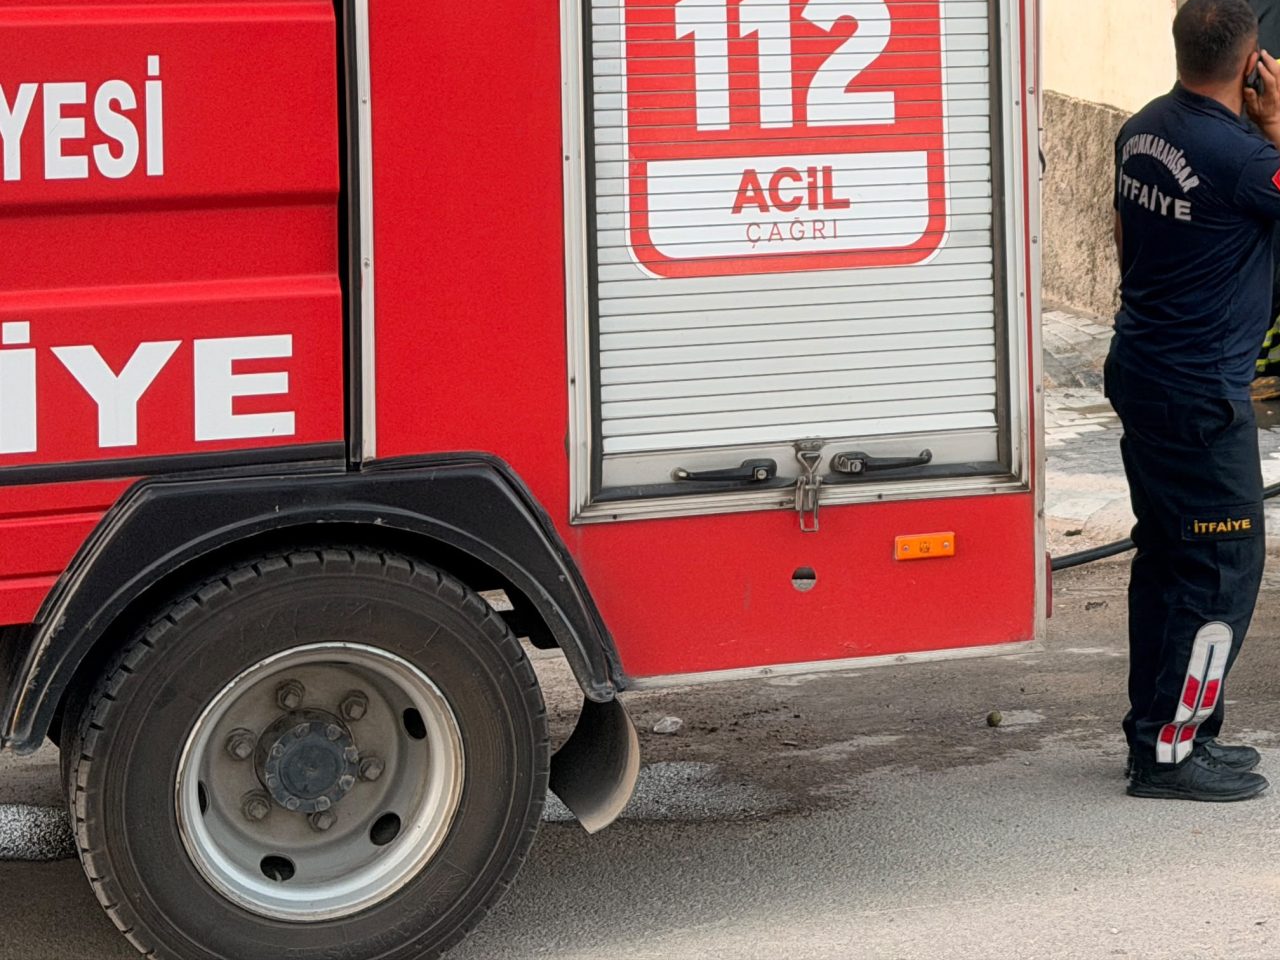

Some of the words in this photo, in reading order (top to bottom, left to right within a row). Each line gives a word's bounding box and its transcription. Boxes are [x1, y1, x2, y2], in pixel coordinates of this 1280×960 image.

[731, 165, 851, 215] ACİL
[745, 216, 838, 248] ÇAĞRI
[1193, 517, 1252, 534] İTFAİYE
